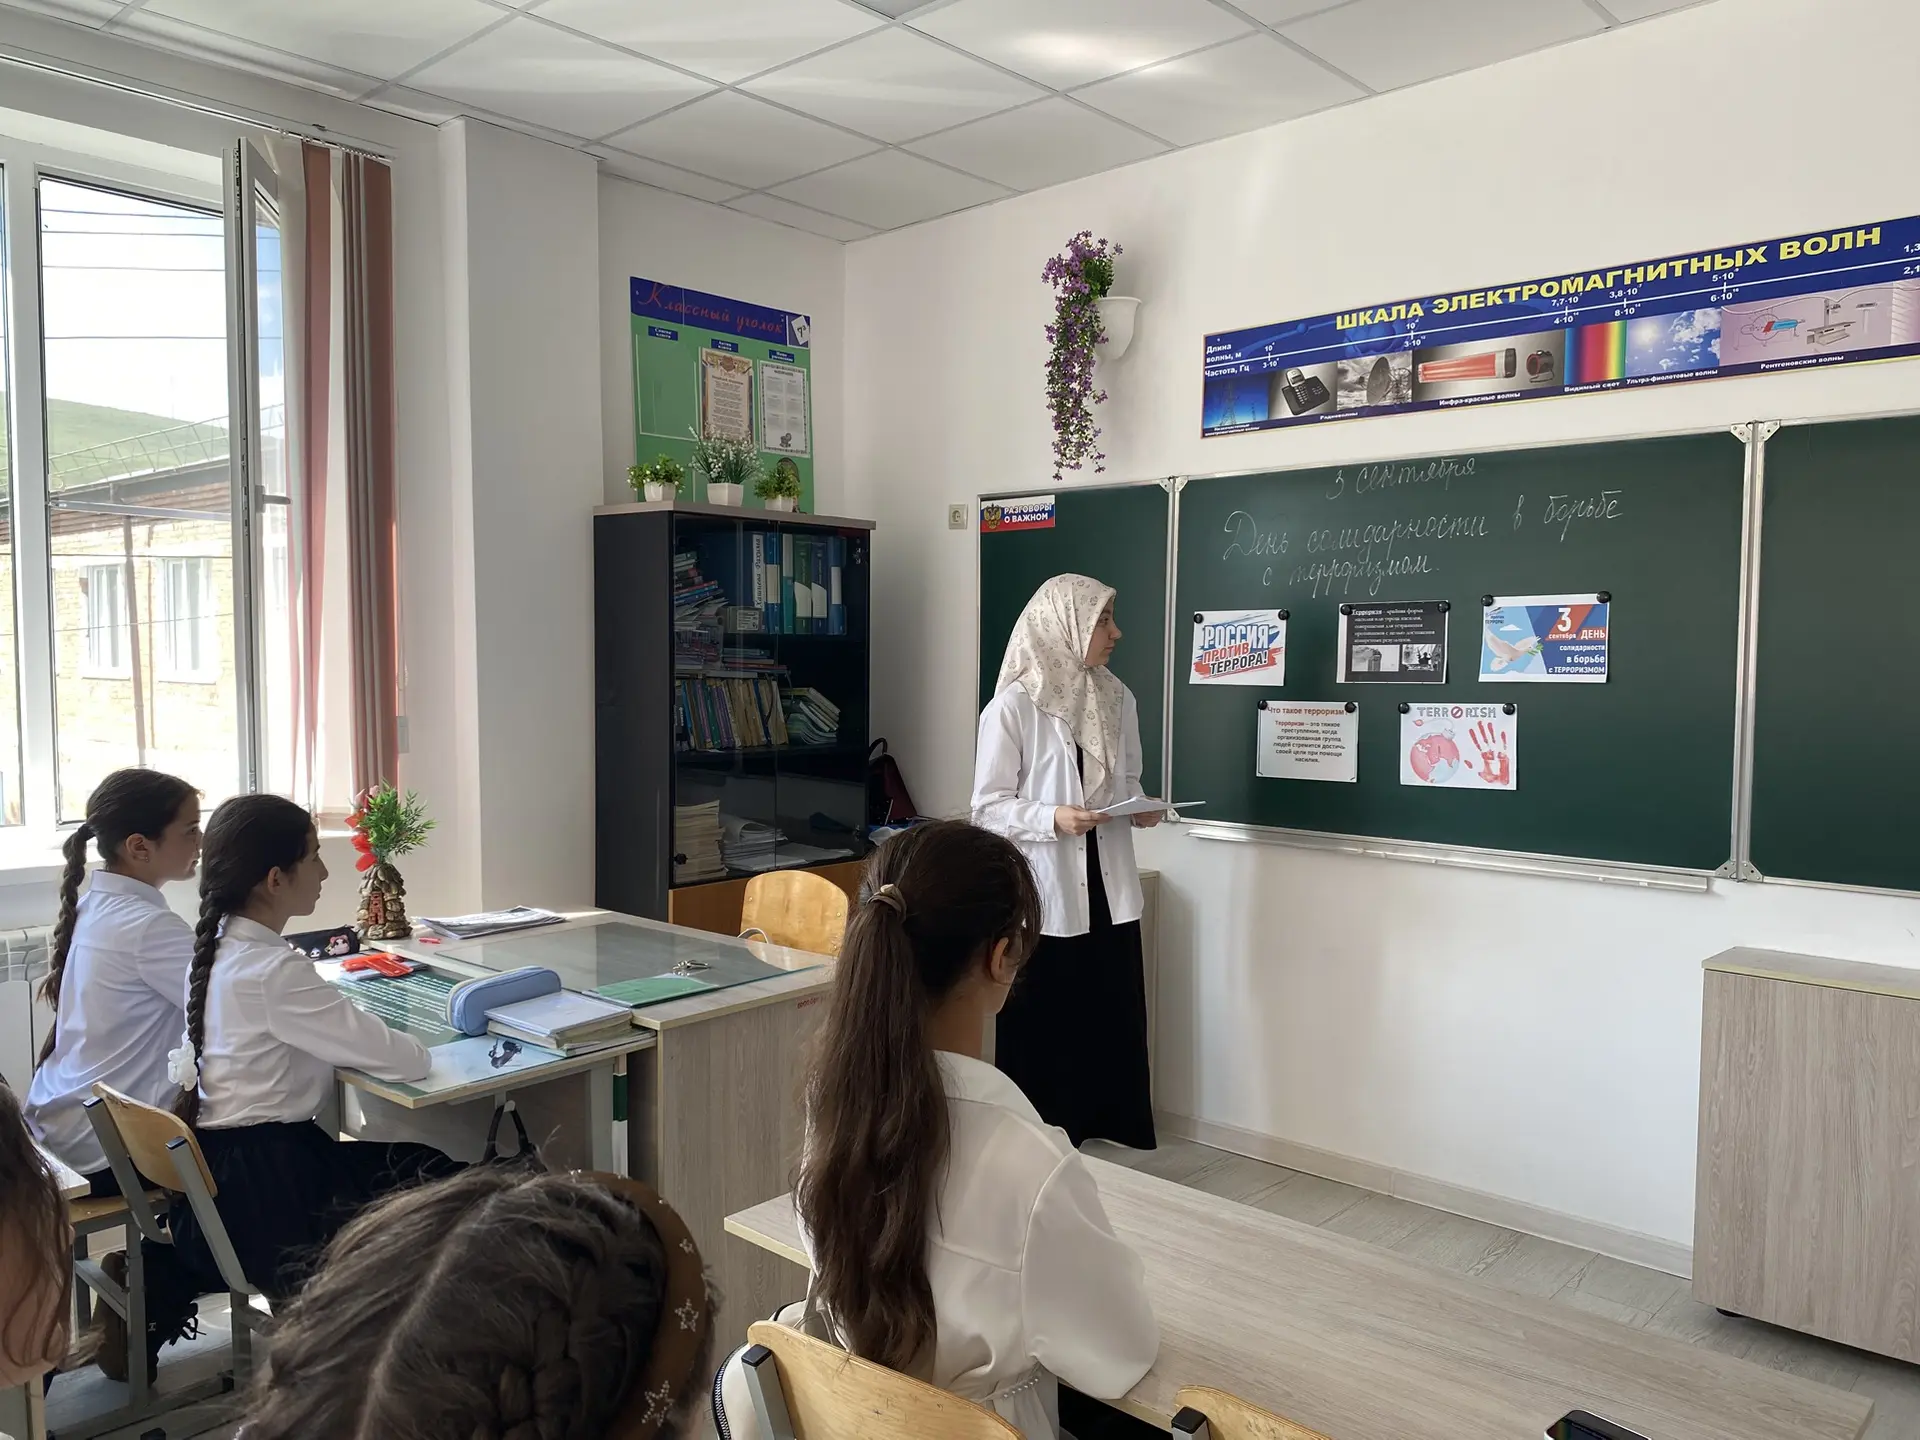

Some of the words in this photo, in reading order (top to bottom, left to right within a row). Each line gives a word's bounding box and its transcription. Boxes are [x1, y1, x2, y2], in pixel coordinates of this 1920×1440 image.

[1336, 302, 1424, 330] ШКАЛА
[1432, 246, 1768, 314] ЭЛЕКТРОМАГНИТНЫХ
[1780, 227, 1882, 260] ВОЛН
[637, 282, 730, 323] Классный
[736, 315, 783, 333] уголок
[1206, 343, 1232, 355] Длина
[1206, 353, 1234, 363] волны,
[1760, 357, 1817, 370] Рентгеновские
[1818, 354, 1844, 363] волны
[1205, 366, 1238, 378] Частота,
[1239, 364, 1250, 373] Гц
[1626, 372, 1694, 386] Ультра-фиолетовые
[1694, 369, 1718, 377] волны
[1564, 382, 1601, 393] Видимый
[1602, 381, 1620, 389] свет
[1439, 394, 1496, 406] Инфра-красные
[1497, 391, 1521, 400] волны
[1325, 469, 1345, 500] 3
[1004, 503, 1052, 515] РАЗГОВОРЫ
[1004, 516, 1010, 524] О
[1012, 512, 1048, 523] ВАЖНОМ
[1223, 510, 1289, 561] День
[1307, 514, 1489, 564] солидарности
[1512, 494, 1525, 531] в
[1543, 489, 1624, 542] борьбе
[1262, 566, 1274, 586] с
[1557, 607, 1571, 632] 3
[1203, 623, 1270, 650] РОССИЯ
[1548, 632, 1576, 640] сентября
[1580, 629, 1605, 640] ДЕНЬ
[1203, 643, 1249, 665] ПРОТИВ
[1559, 644, 1605, 652] солидарности
[1210, 651, 1267, 675] ТЕРРОРА!
[1573, 654, 1605, 665] борьбе
[1554, 666, 1605, 674] ТЕРРОРИЗМОМ
[1267, 706, 1281, 714] Что
[1274, 720, 1305, 728] Терроризм
[1281, 728, 1321, 736] преступление,
[1276, 735, 1322, 743] организованная
[1273, 741, 1292, 749] людей
[1291, 742, 1321, 750] стремится
